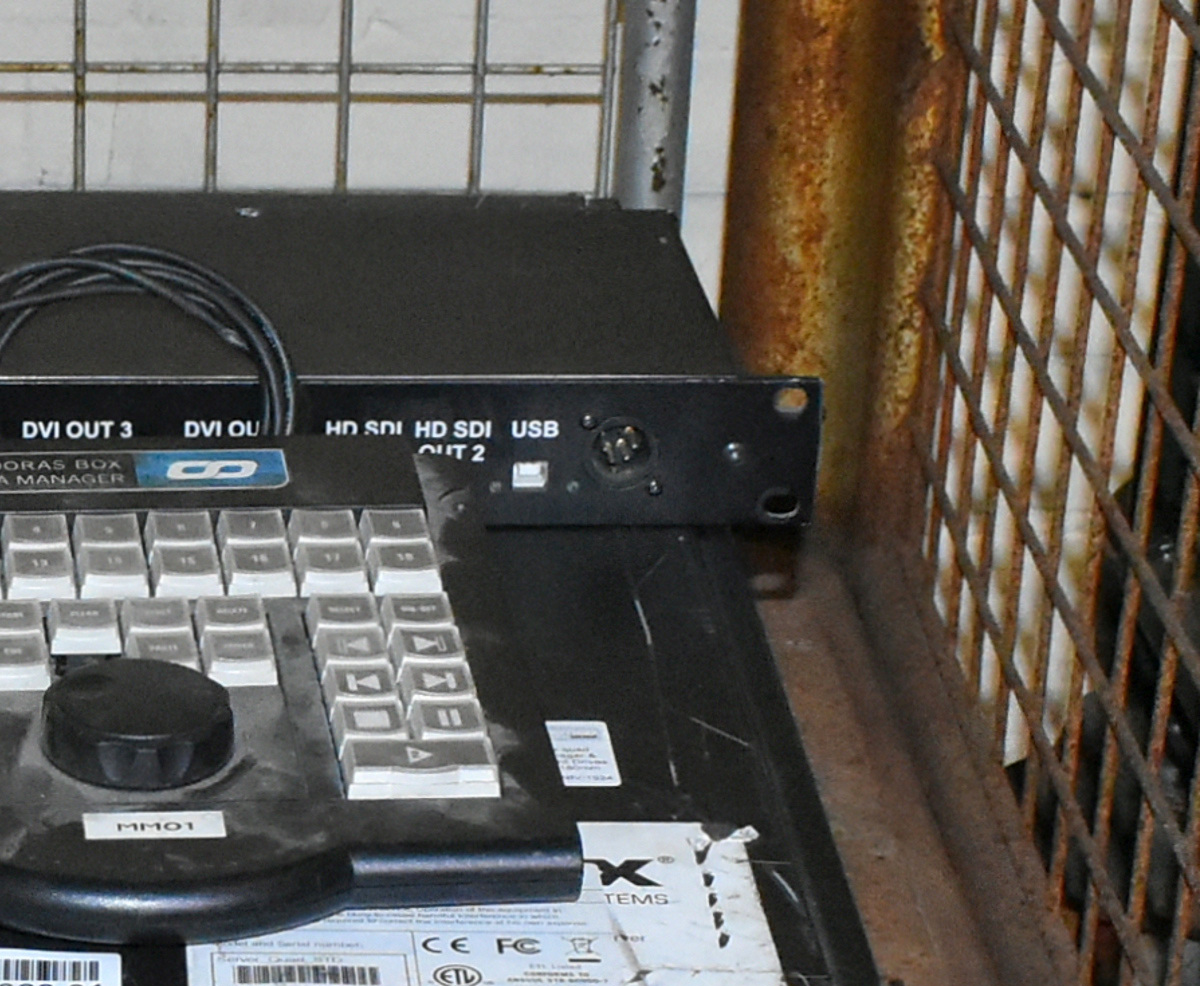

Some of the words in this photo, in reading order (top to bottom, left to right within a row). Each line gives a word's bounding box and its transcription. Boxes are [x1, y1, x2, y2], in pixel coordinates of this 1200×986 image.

[22, 421, 60, 439] DVI
[65, 421, 114, 439] OUT
[119, 421, 133, 439] 3
[184, 420, 222, 438] DVI
[227, 420, 260, 437] OU
[325, 420, 358, 436] HD
[364, 420, 403, 436] SDI
[414, 420, 448, 438] HD
[453, 420, 492, 438] SDI
[511, 420, 560, 438] USB
[471, 444, 486, 462] 2
[74, 459, 122, 470] BOX
[15, 473, 126, 485] MANAGER
[604, 892, 669, 905] TEMS
